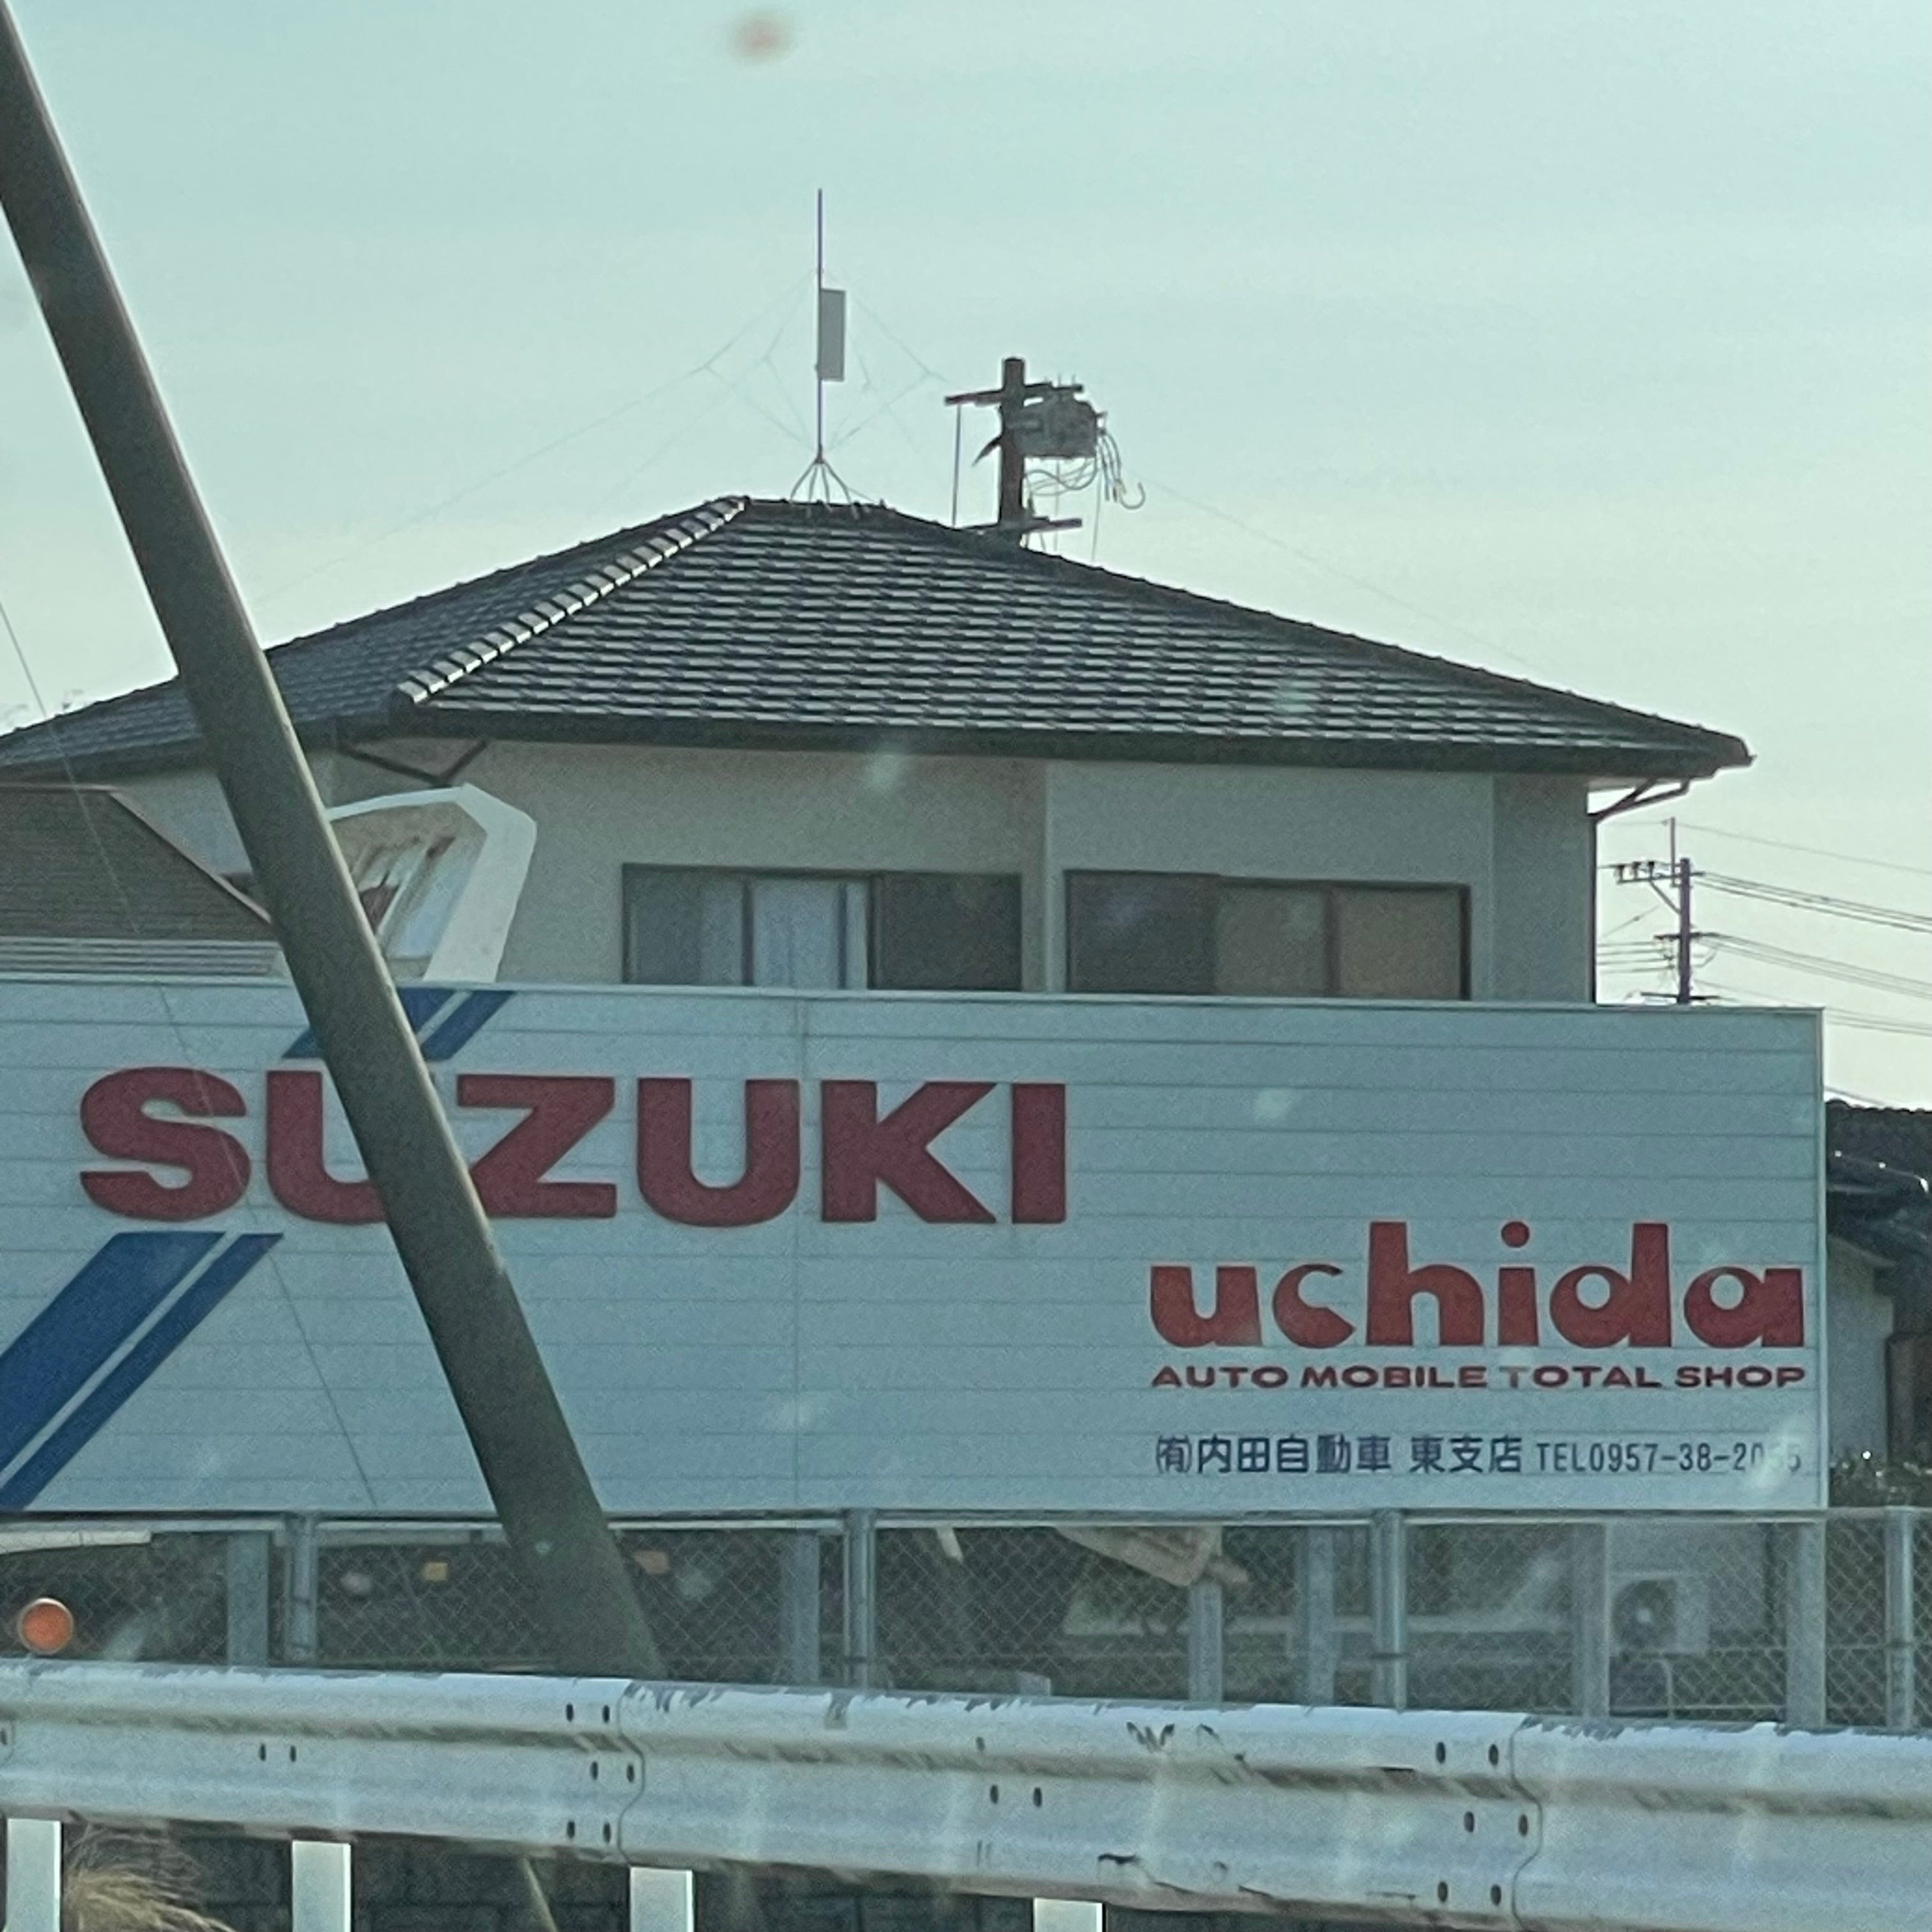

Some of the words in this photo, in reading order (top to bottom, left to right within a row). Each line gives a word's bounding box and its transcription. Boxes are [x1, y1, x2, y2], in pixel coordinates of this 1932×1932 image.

[80, 1066, 1066, 1227] SUZUKI
[1151, 1221, 1805, 1349] uchida
[1151, 1365, 1288, 1389] AUTO
[1300, 1365, 1487, 1389] MOBILE
[1499, 1365, 1662, 1389] TOTAL
[1675, 1365, 1805, 1389] SHOP
[1409, 1435, 1522, 1473] 東支店
[1537, 1442, 1802, 1473] TEL0957-38-205
